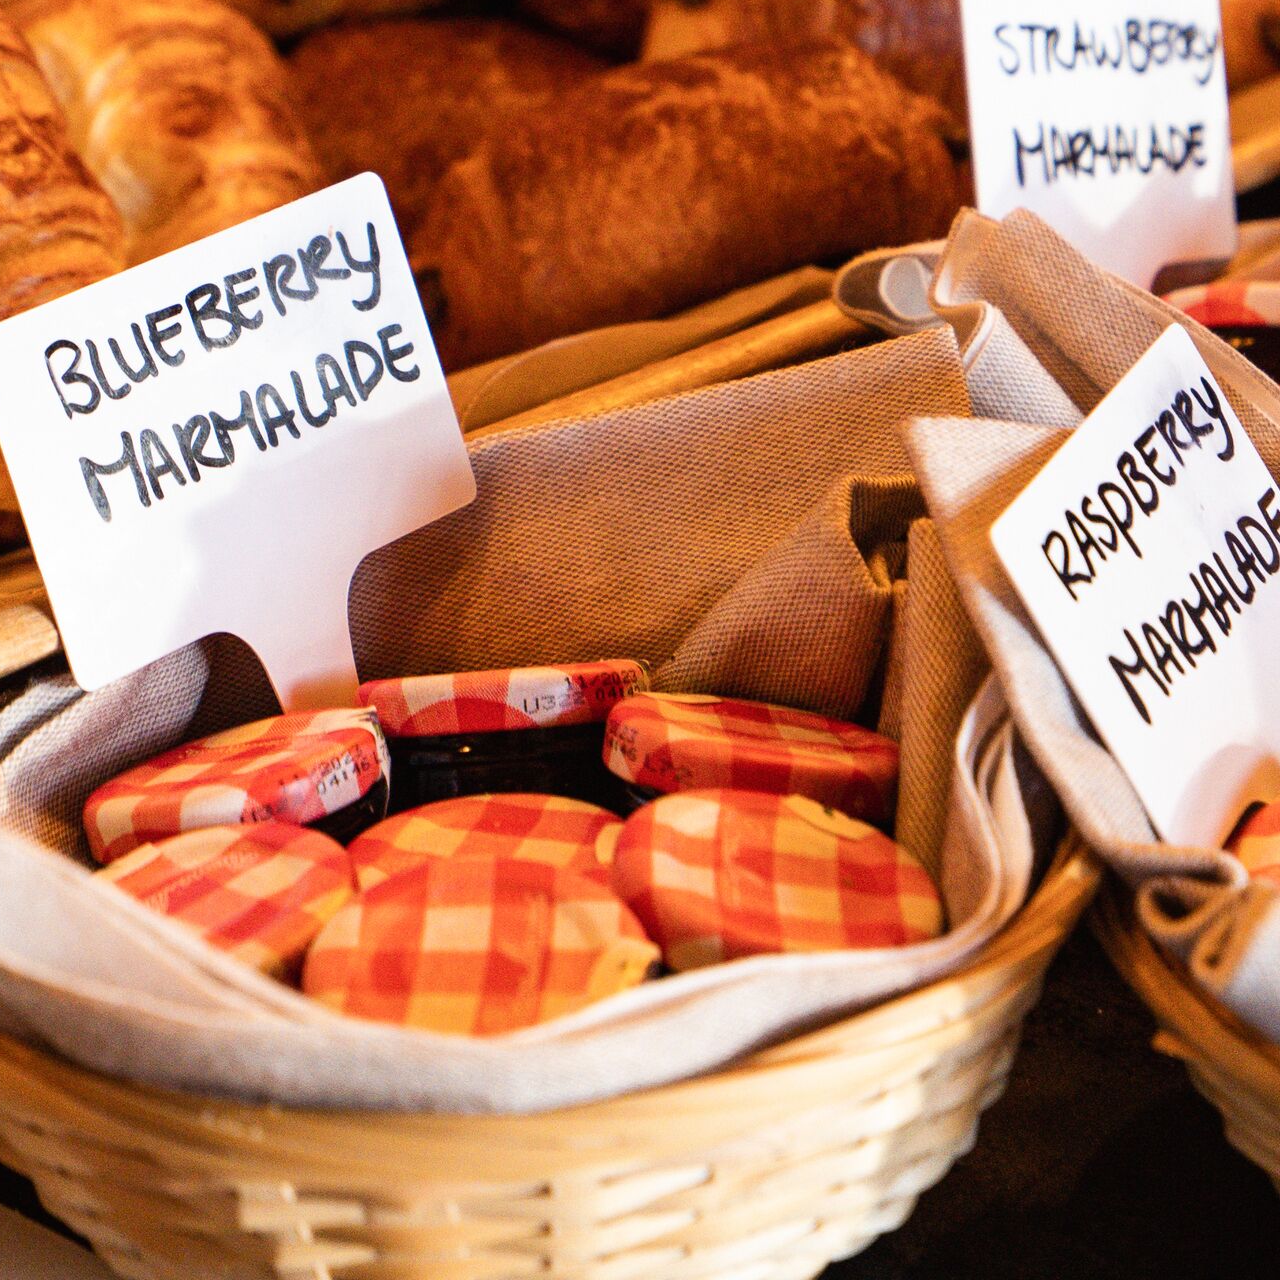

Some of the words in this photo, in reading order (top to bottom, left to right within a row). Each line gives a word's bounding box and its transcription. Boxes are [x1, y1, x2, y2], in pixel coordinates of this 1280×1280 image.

[993, 18, 1218, 86] STRAWBERRY
[1012, 120, 1208, 187] MARMALADE
[43, 220, 382, 420] BLUEBERRY
[77, 322, 422, 523] MARMALADE
[1040, 375, 1235, 602] RASPBERRY
